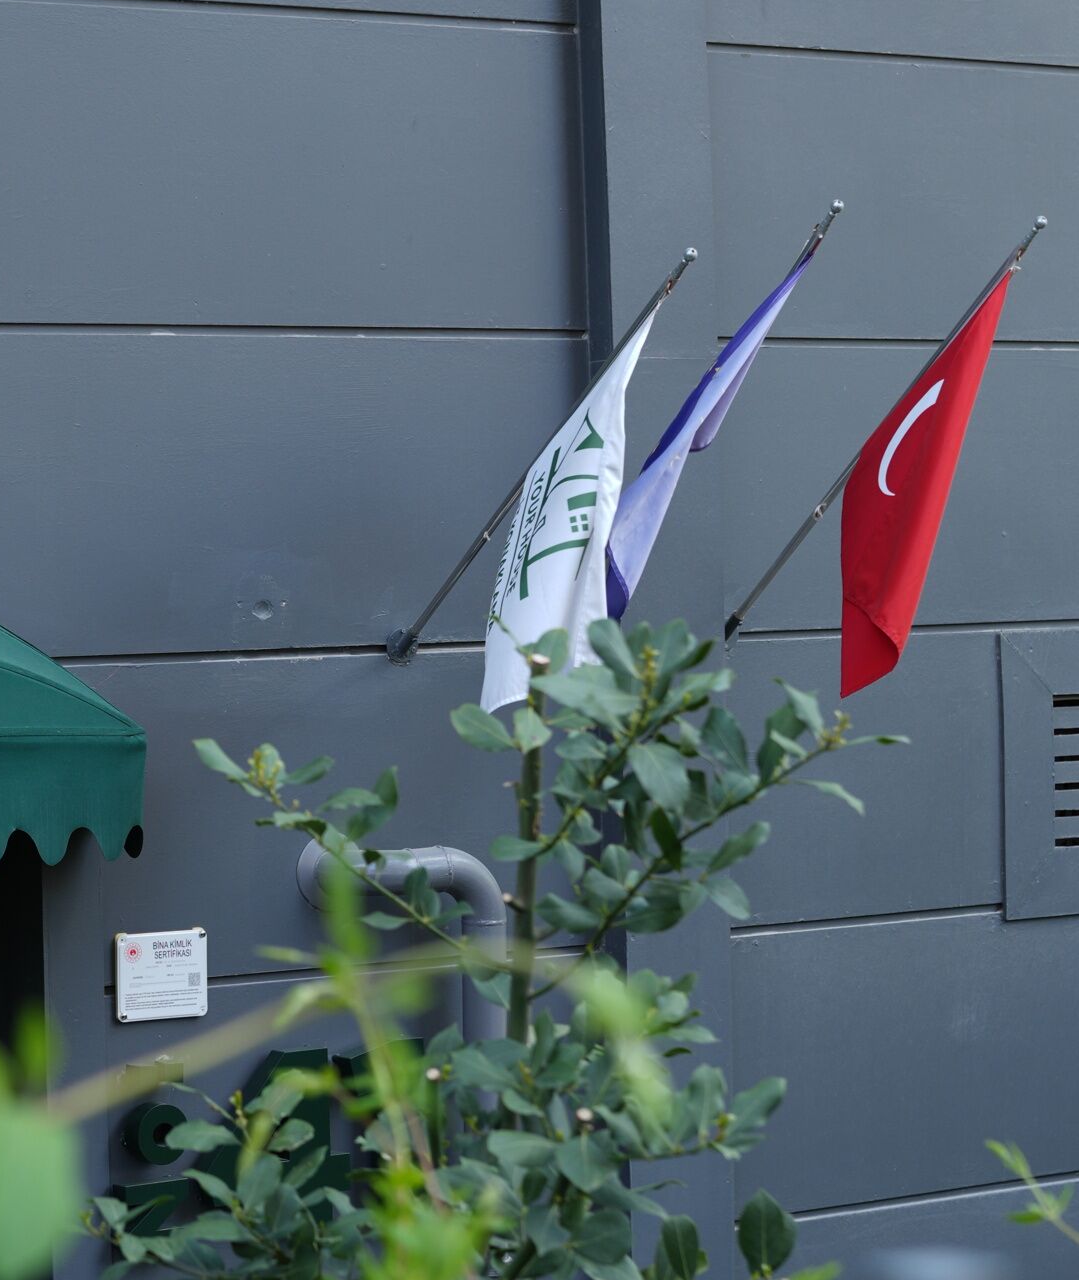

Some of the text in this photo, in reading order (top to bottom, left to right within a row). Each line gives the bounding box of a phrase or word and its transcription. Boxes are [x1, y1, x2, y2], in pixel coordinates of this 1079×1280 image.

[524, 471, 546, 526] YOUR
[153, 939, 192, 950] BİNA KİMLİK
[154, 949, 191, 959] SERTİFİKASI
